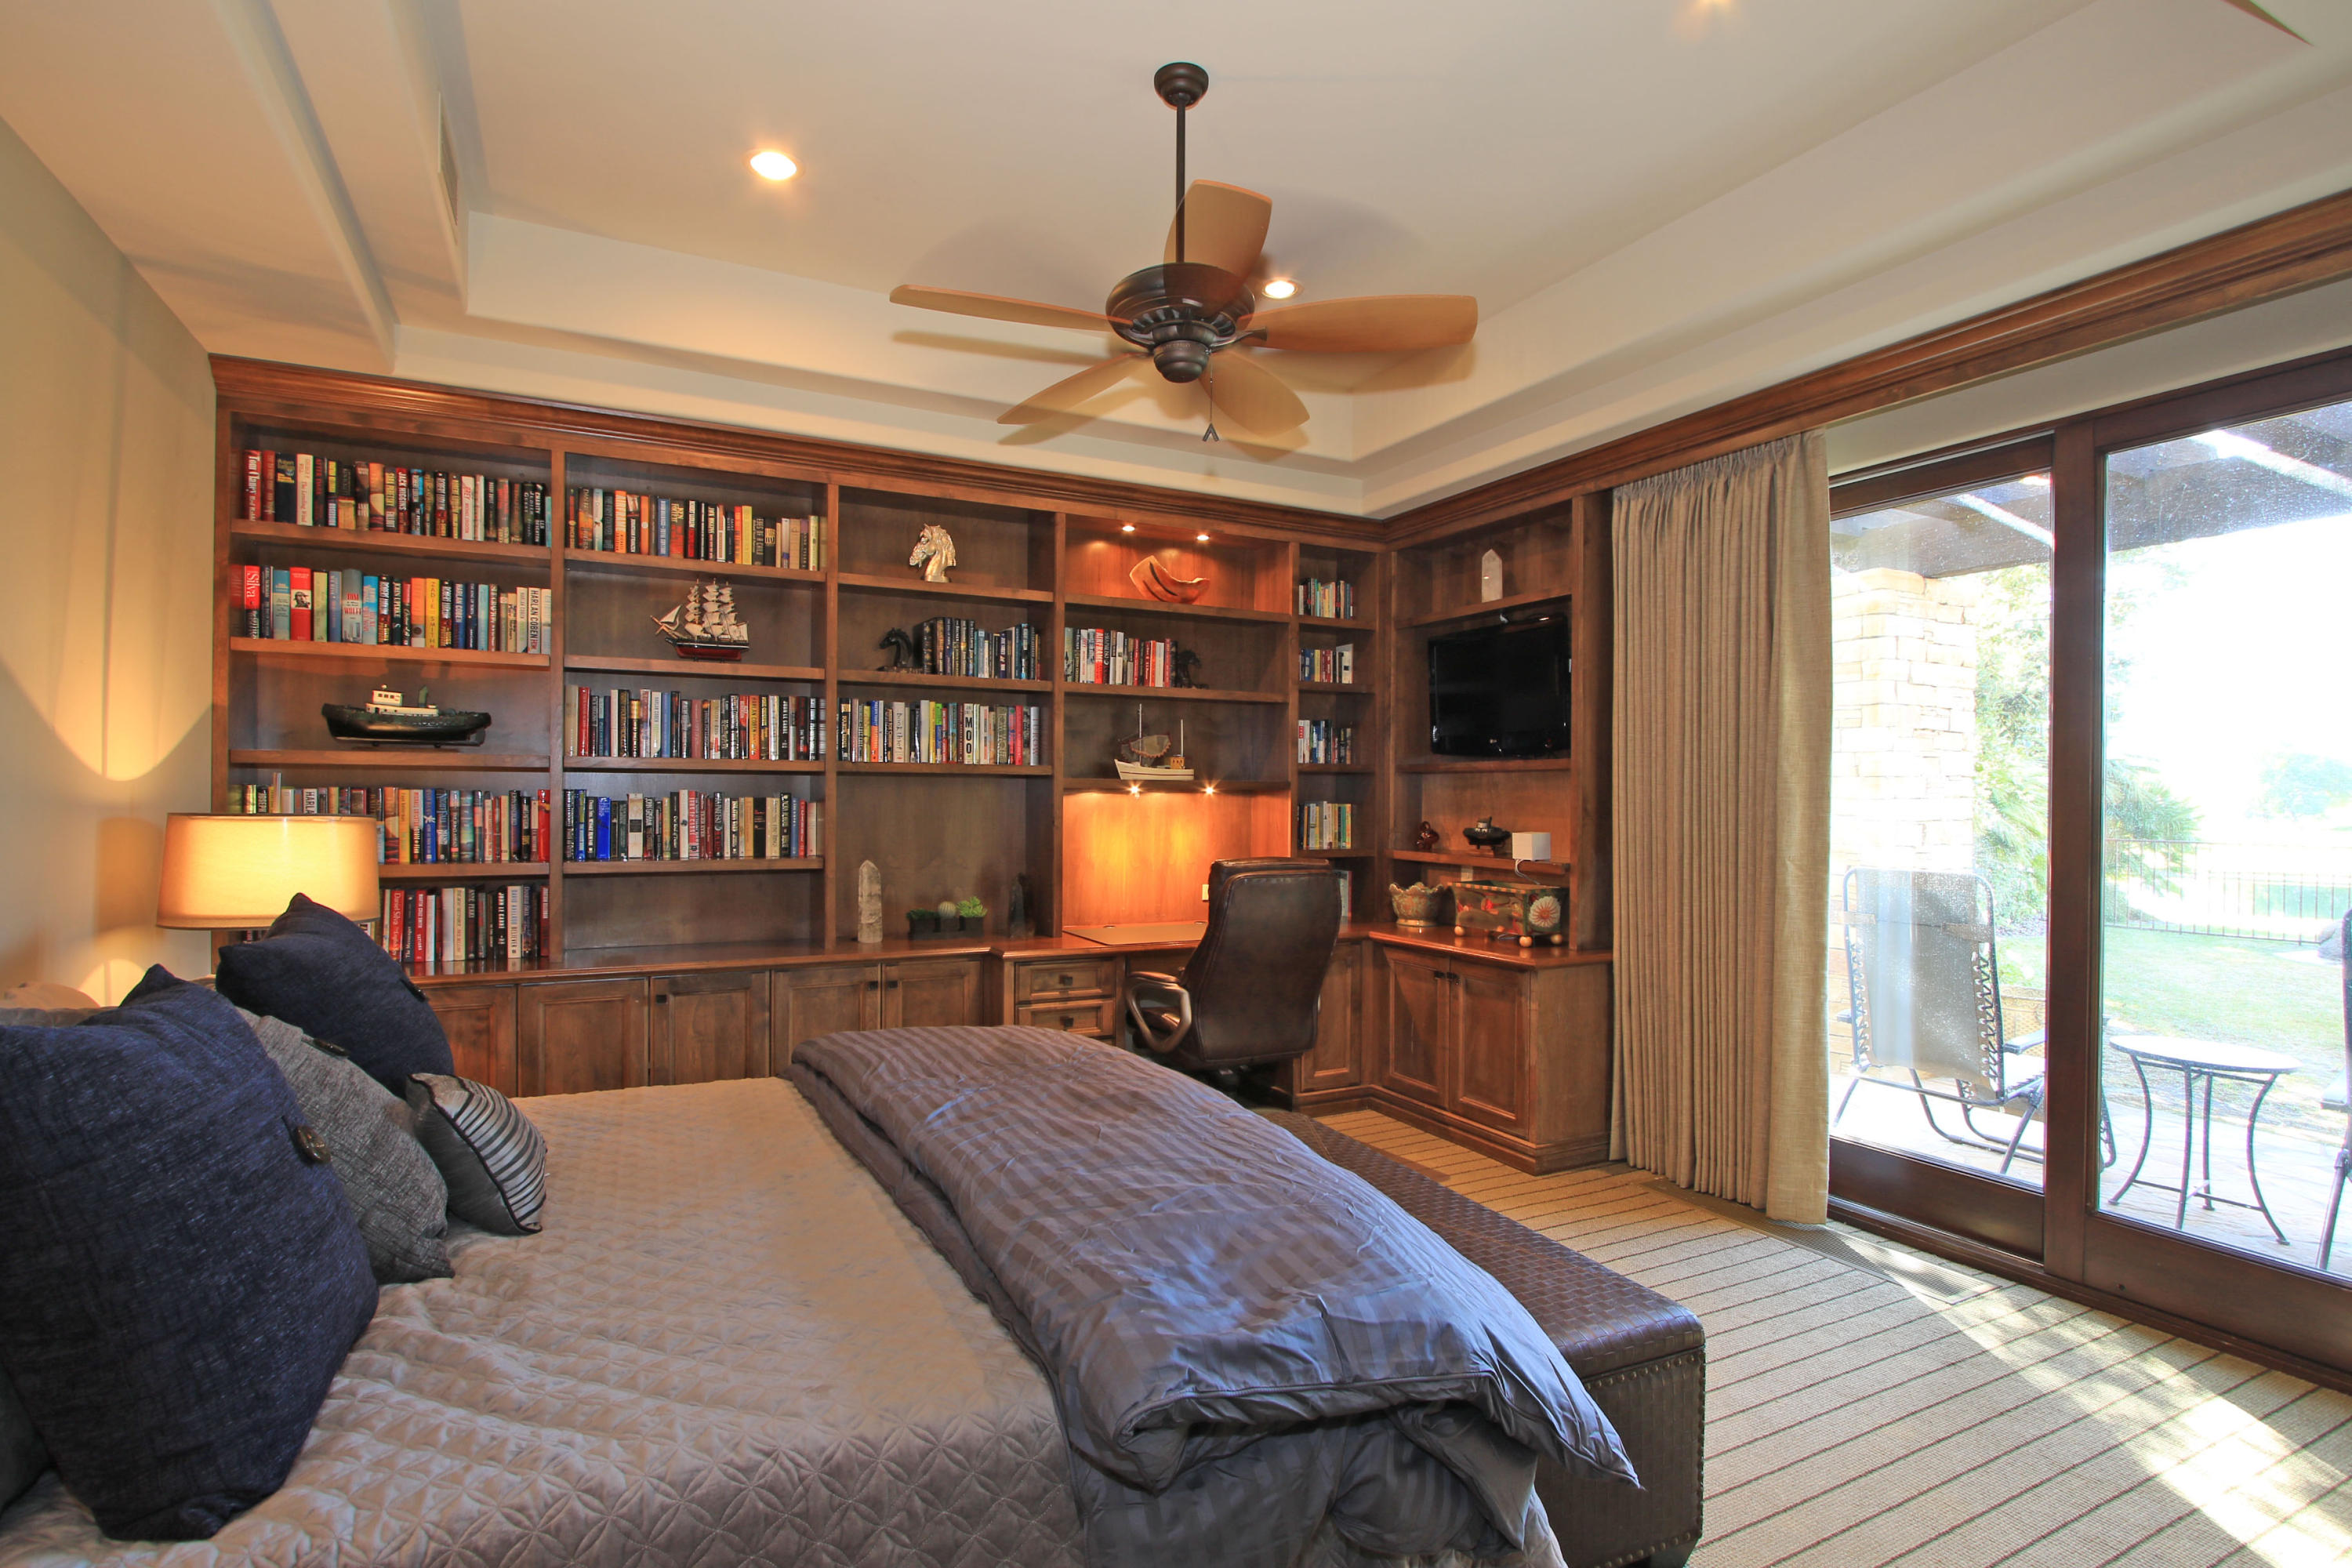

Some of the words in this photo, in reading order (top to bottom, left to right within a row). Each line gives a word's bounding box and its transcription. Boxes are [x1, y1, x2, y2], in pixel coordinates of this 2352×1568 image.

[249, 456, 260, 471] Tom
[246, 472, 260, 495] Clancy
[398, 472, 407, 486] JACK
[436, 477, 445, 494] ROBERT
[398, 488, 407, 510] HIGGINS
[436, 494, 445, 510] LUDLUM
[615, 495, 626, 532] AIRFRAME
[246, 572, 260, 597] Silva
[393, 583, 401, 597] JOHN
[530, 590, 539, 615] HARLAN
[530, 617, 539, 639] COBEN
[305, 792, 315, 814] HARLA
[510, 927, 519, 947] BELIEVER
